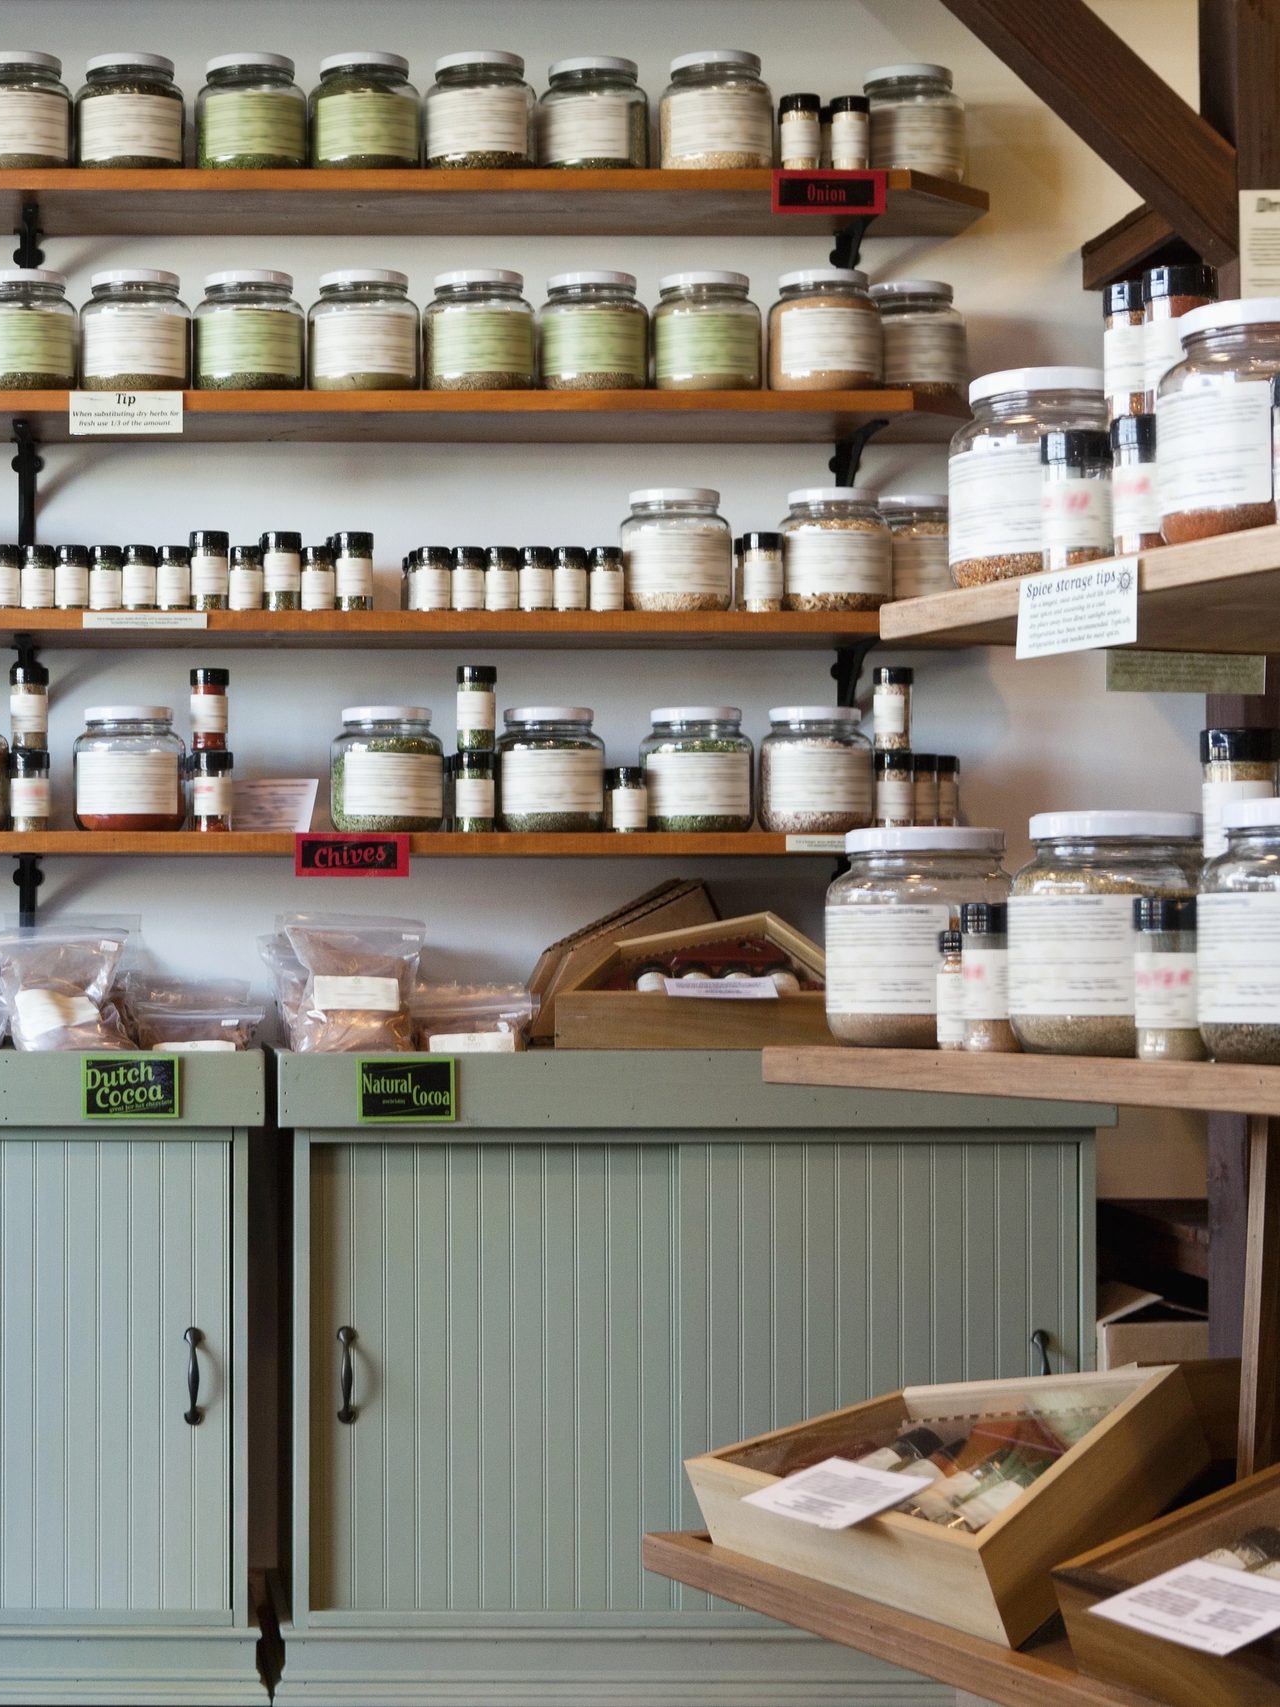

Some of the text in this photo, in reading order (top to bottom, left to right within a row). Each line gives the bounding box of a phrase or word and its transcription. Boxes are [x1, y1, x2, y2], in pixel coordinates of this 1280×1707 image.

[807, 183, 847, 202] Onion
[115, 392, 137, 407] Tip
[72, 410, 93, 418] When
[94, 410, 135, 418] substituting
[1026, 569, 1116, 600] Spice storage tips
[314, 845, 387, 868] Chives
[86, 1061, 155, 1089] Dutch
[363, 1072, 412, 1094] Natural
[95, 1084, 164, 1108] Cocoa
[412, 1084, 450, 1106] Cocoa
